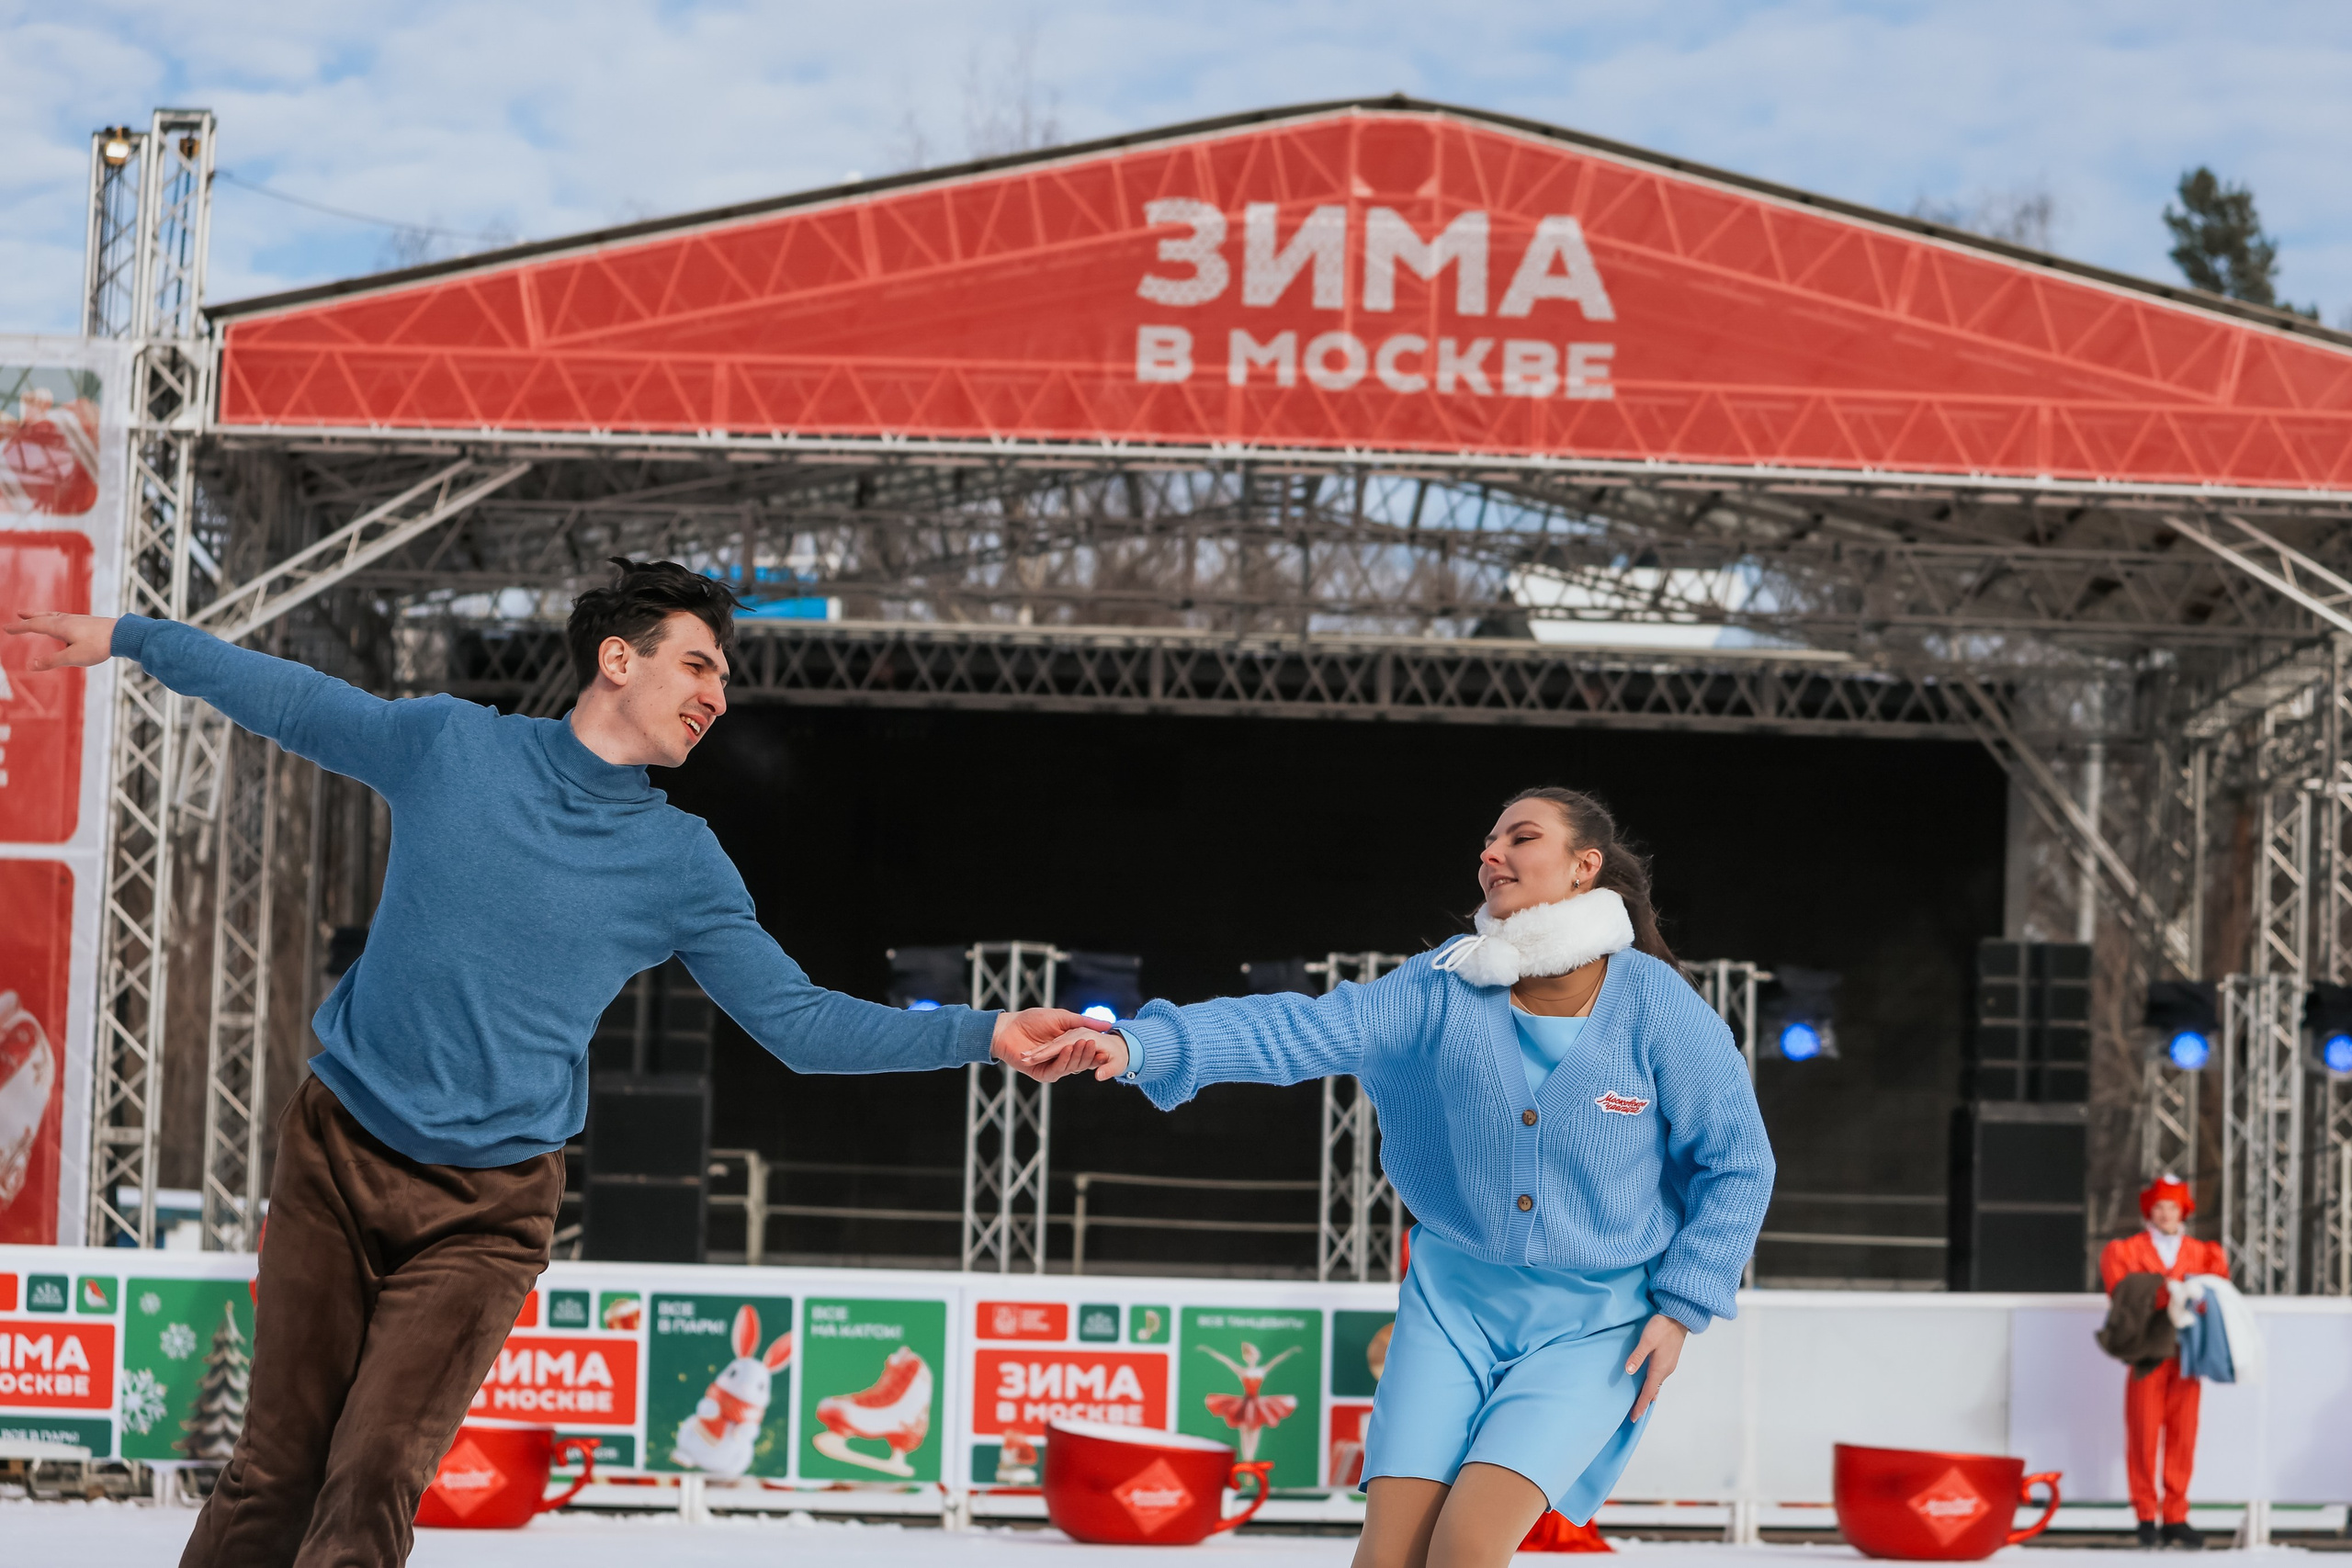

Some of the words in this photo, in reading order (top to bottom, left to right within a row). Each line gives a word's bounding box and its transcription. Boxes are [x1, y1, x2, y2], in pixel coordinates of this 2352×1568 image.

[1136, 197, 1616, 321] ЗИМА
[1136, 325, 1193, 382] В
[1227, 329, 1615, 400] МОСКВЕ
[0, 1372, 90, 1397] ОСКВЕ
[996, 1361, 1145, 1402] ЗИМА
[493, 1388, 614, 1412] МОСКВЕ
[996, 1401, 1016, 1422] В
[1023, 1403, 1144, 1425] МОСКВЕ
